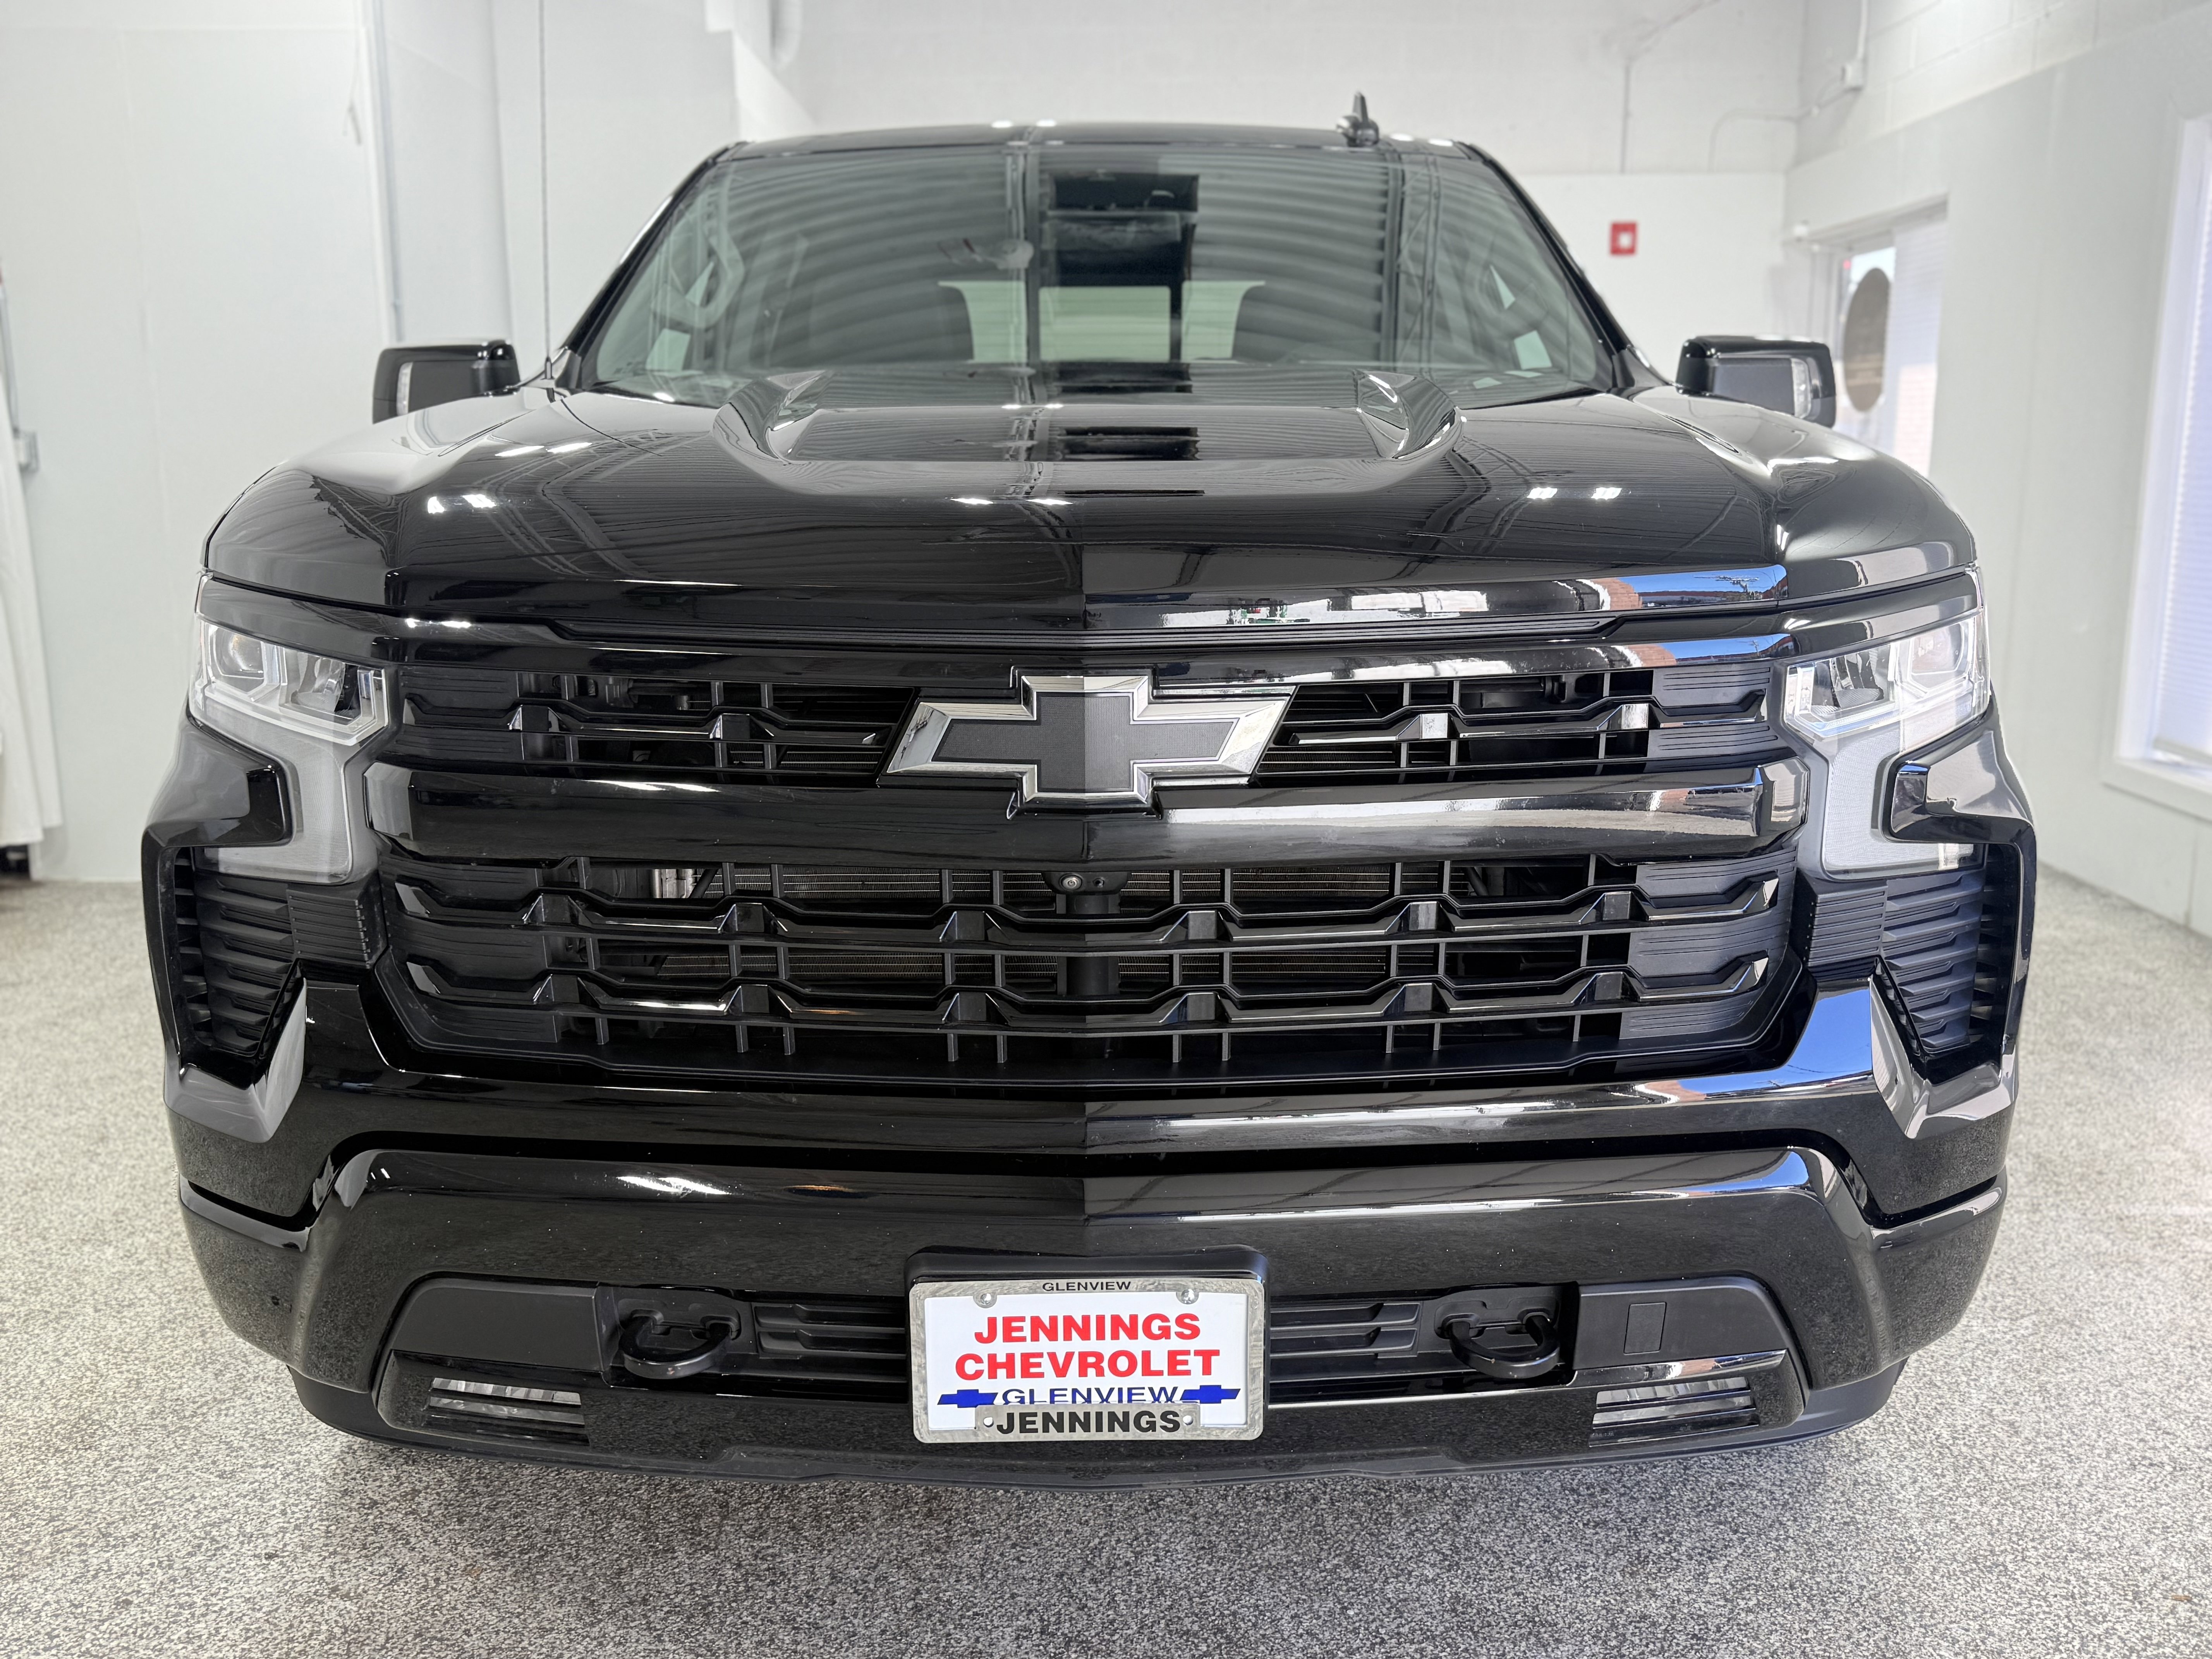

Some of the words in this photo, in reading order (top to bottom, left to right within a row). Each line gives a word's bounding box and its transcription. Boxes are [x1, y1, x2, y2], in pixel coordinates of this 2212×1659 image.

[1042, 1281, 1131, 1291] GLENVIEW
[974, 1313, 1200, 1344] JENNINGS
[955, 1350, 1220, 1381] CHEVROLET
[1002, 1386, 1178, 1404] GLENVIEW
[996, 1410, 1181, 1434] JENNINGS
